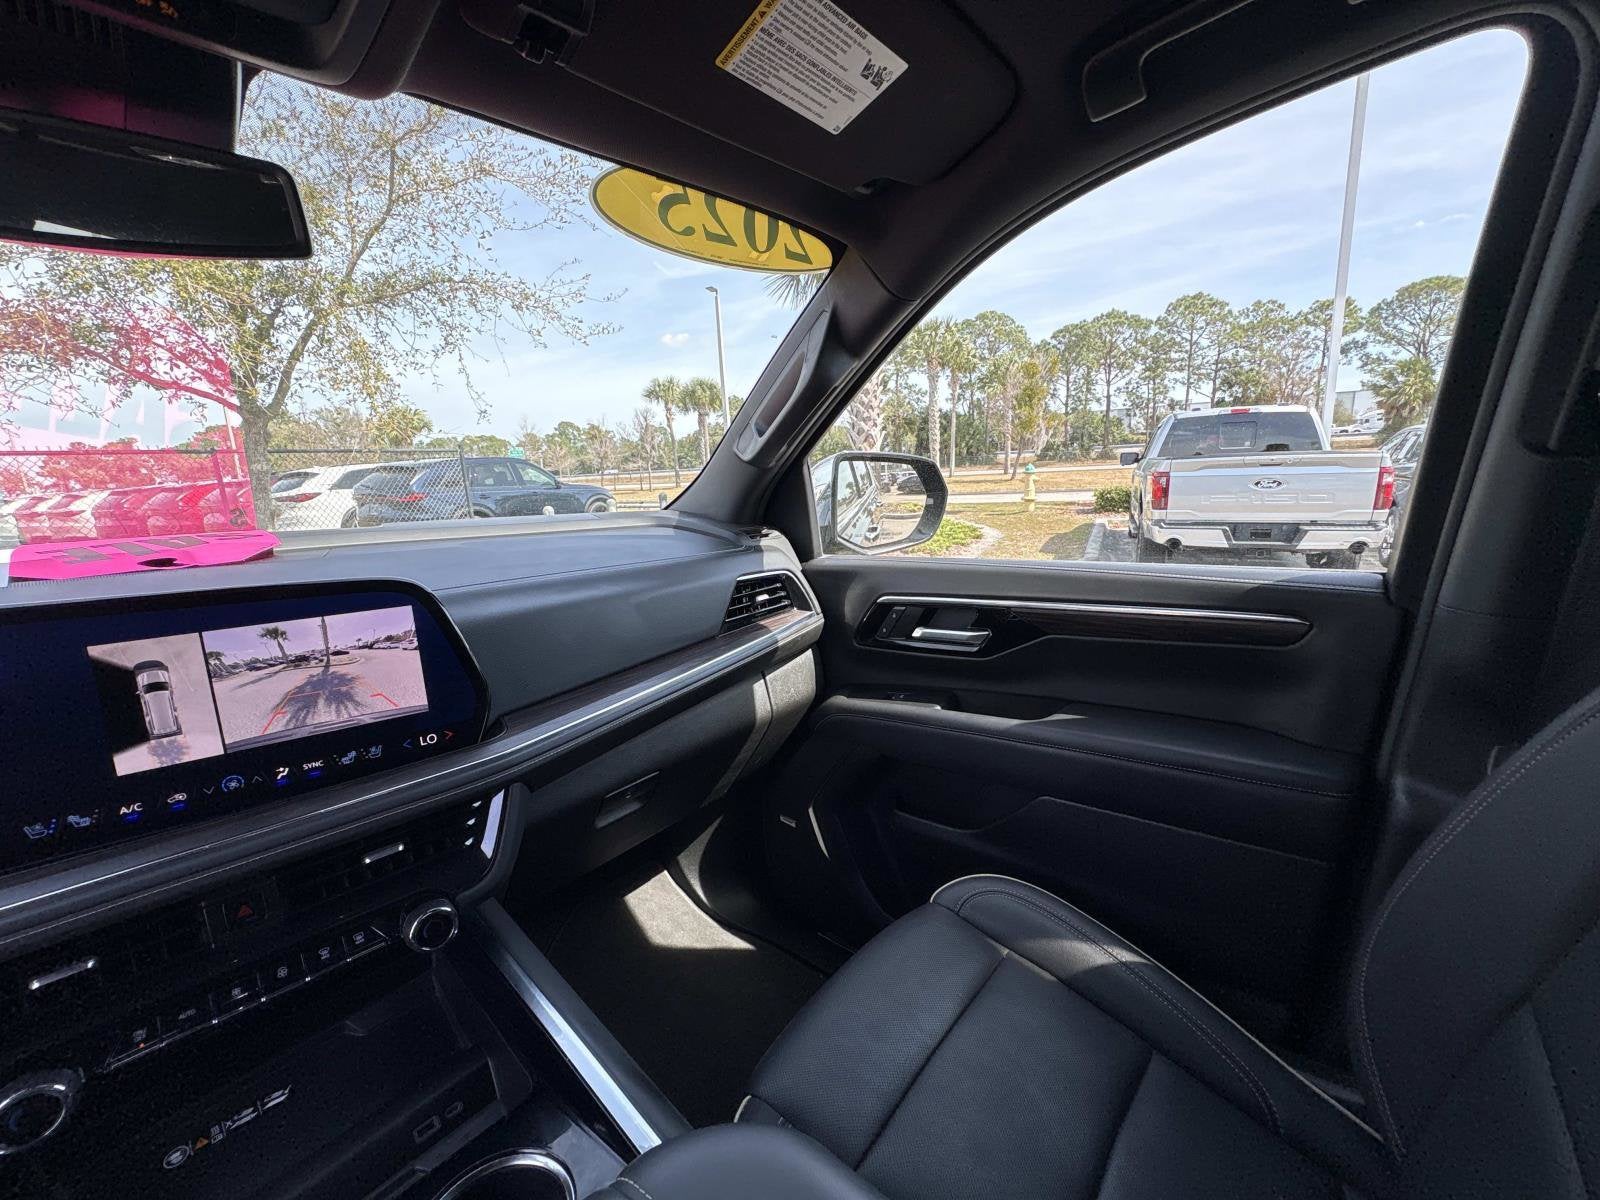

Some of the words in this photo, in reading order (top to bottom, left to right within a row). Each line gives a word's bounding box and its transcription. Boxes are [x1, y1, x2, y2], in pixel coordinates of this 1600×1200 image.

[821, 1, 848, 24] ADVANCED
[846, 20, 857, 31] AIR
[854, 26, 869, 40] BAGS
[719, 17, 760, 66] AVERTISSEMENT
[774, 35, 787, 48] AVEC
[786, 44, 797, 54] DES
[795, 50, 808, 62] SACS
[419, 733, 438, 746] LO
[302, 759, 325, 771] SYNC
[119, 802, 144, 816] A/C
